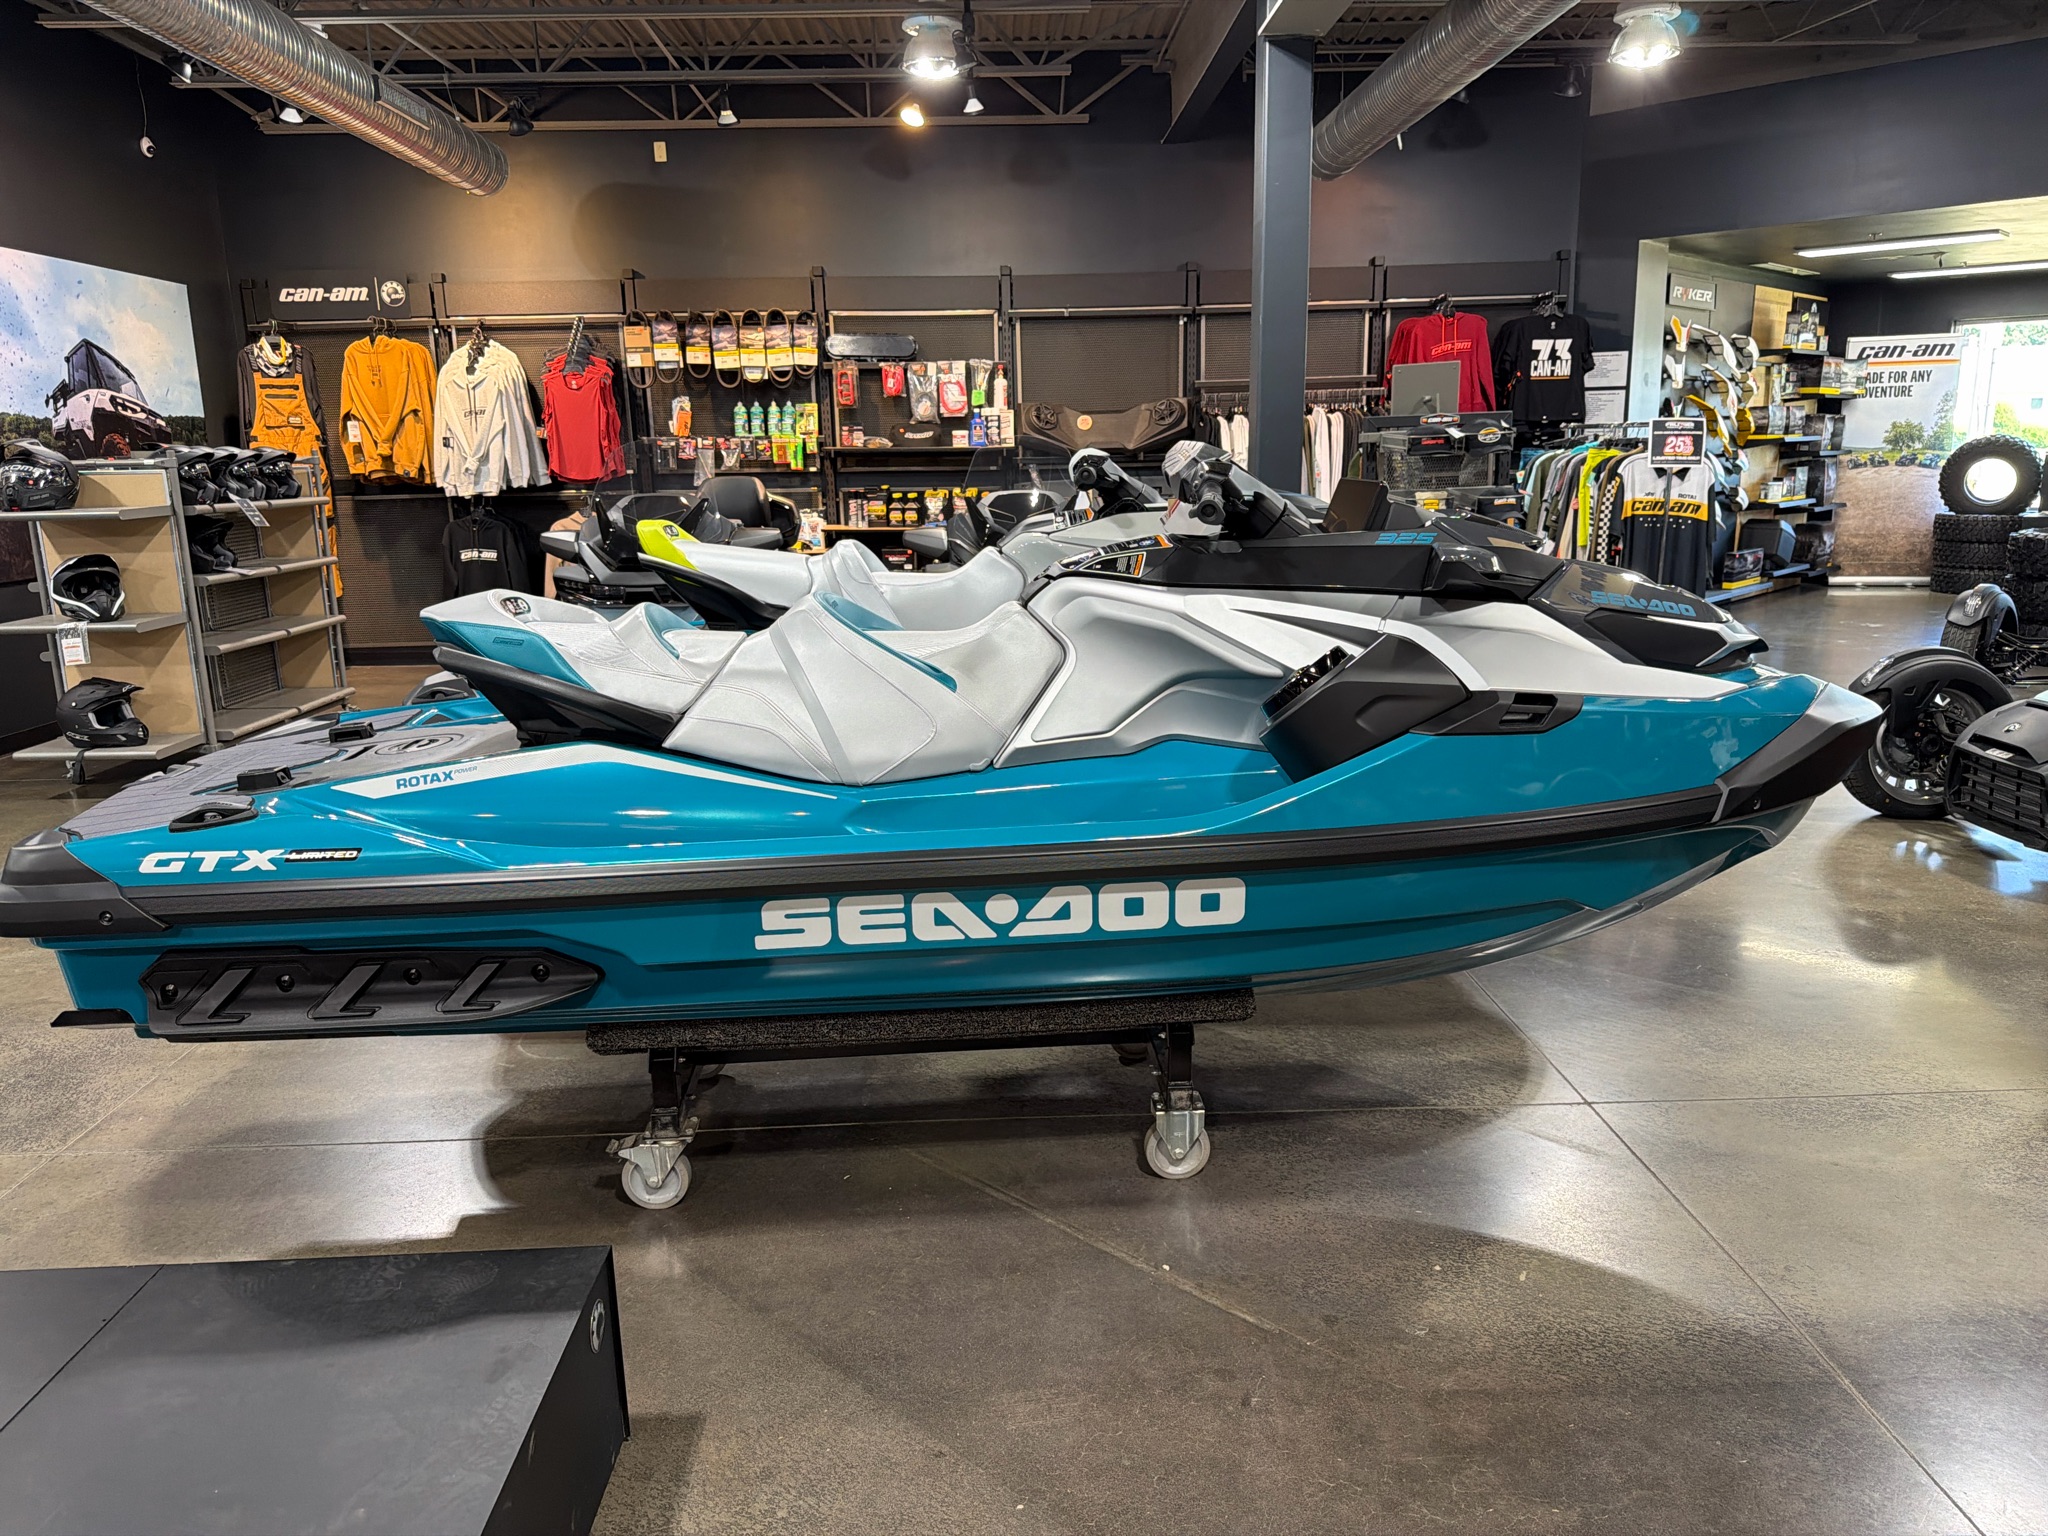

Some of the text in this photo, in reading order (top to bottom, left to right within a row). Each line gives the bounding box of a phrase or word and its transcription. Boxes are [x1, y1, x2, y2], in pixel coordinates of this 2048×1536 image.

[279, 287, 367, 302] can-am
[1673, 286, 1712, 302] RYKER
[1431, 341, 1472, 356] can-am
[1531, 338, 1573, 360] 73
[1857, 343, 1956, 361] can-am
[1530, 359, 1571, 377] CAN-AM
[1865, 369, 1932, 384] ADE FOR ANY
[1857, 385, 1913, 398] DVENTURE
[1374, 532, 1438, 545] 325
[461, 551, 498, 560] can-am
[396, 765, 478, 790] ROTAX POWER
[138, 849, 359, 874] GTX LIMITED
